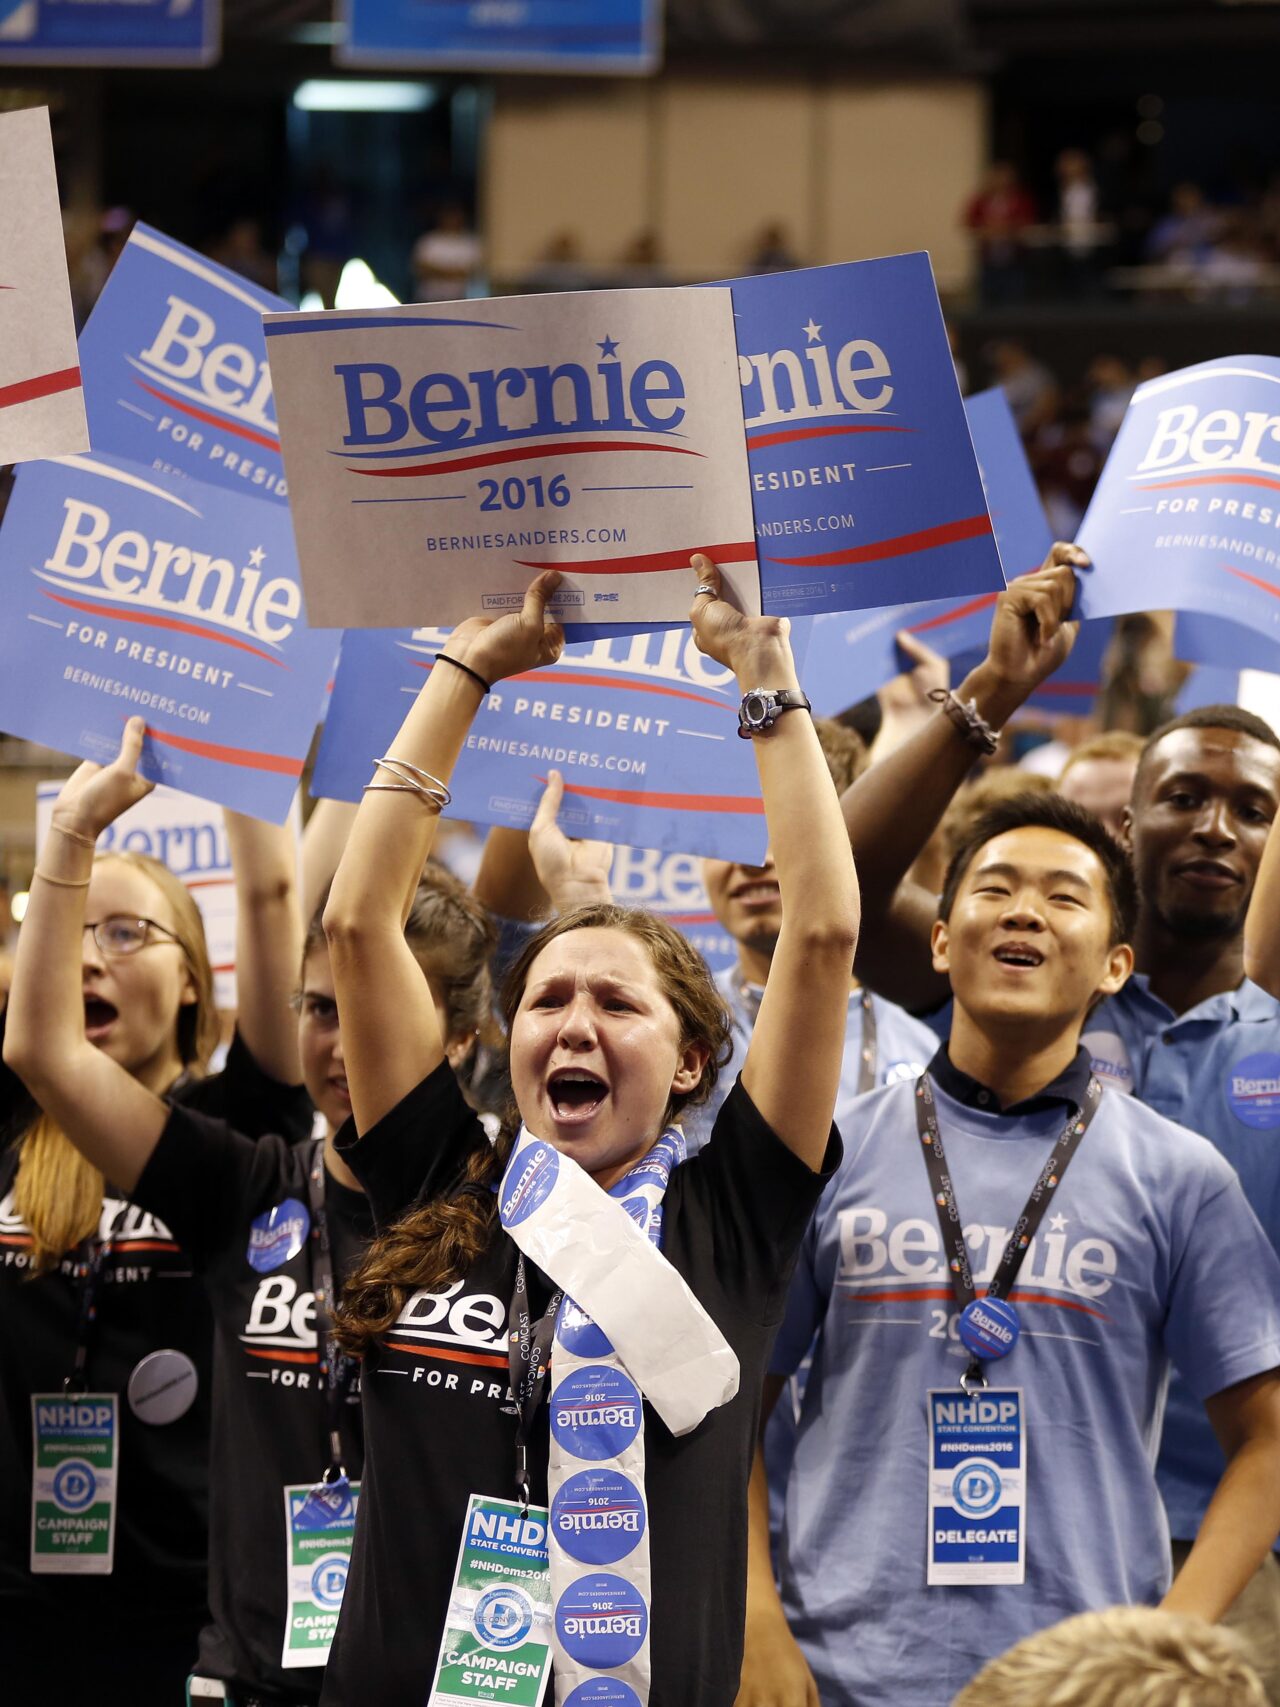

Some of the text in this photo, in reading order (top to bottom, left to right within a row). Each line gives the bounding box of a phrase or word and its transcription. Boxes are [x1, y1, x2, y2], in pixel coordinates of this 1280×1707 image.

[333, 334, 687, 447] Bernie
[157, 416, 204, 451] FOR
[478, 474, 571, 512] 2016
[1155, 497, 1199, 515] FOR
[426, 528, 627, 551] BERNIESANDERS.COM
[44, 497, 302, 643] Bernie
[66, 621, 235, 689] FOR PRESIDENT
[63, 665, 212, 725] BERNIESANDERS.COM
[515, 699, 671, 737] PRESIDENT
[502, 1148, 547, 1218] Bernie
[1032, 1158, 1058, 1203] COMCAST
[1003, 1215, 1029, 1265] COMCAST
[955, 1239, 973, 1290] COMCAST
[519, 1311, 530, 1361] COMCAST
[969, 1307, 1014, 1344] Bernie
[271, 1368, 310, 1388] FOR
[412, 1367, 459, 1391] FOR
[526, 1347, 542, 1398] COMCAST
[585, 1393, 606, 1402] 2016
[39, 1406, 111, 1427] NHDP
[556, 1408, 636, 1432] Bernie
[935, 1402, 1018, 1424] NHDP
[937, 1424, 1016, 1433] STATE CONVENTION
[940, 1443, 1013, 1453] #NHDems2016
[588, 1497, 609, 1506] 2016
[37, 1518, 108, 1531] CAMPAIGN
[471, 1511, 547, 1546] NHD
[559, 1512, 639, 1536] Bernie
[52, 1533, 94, 1545] STAFF
[470, 1538, 549, 1559] STATE CONVENTI
[935, 1529, 1017, 1544] DELEGATE
[592, 1602, 613, 1610] 2016
[564, 1617, 642, 1640] Bernie
[446, 1650, 541, 1678] CAMPAIGN
[461, 1671, 518, 1691] STAFF
